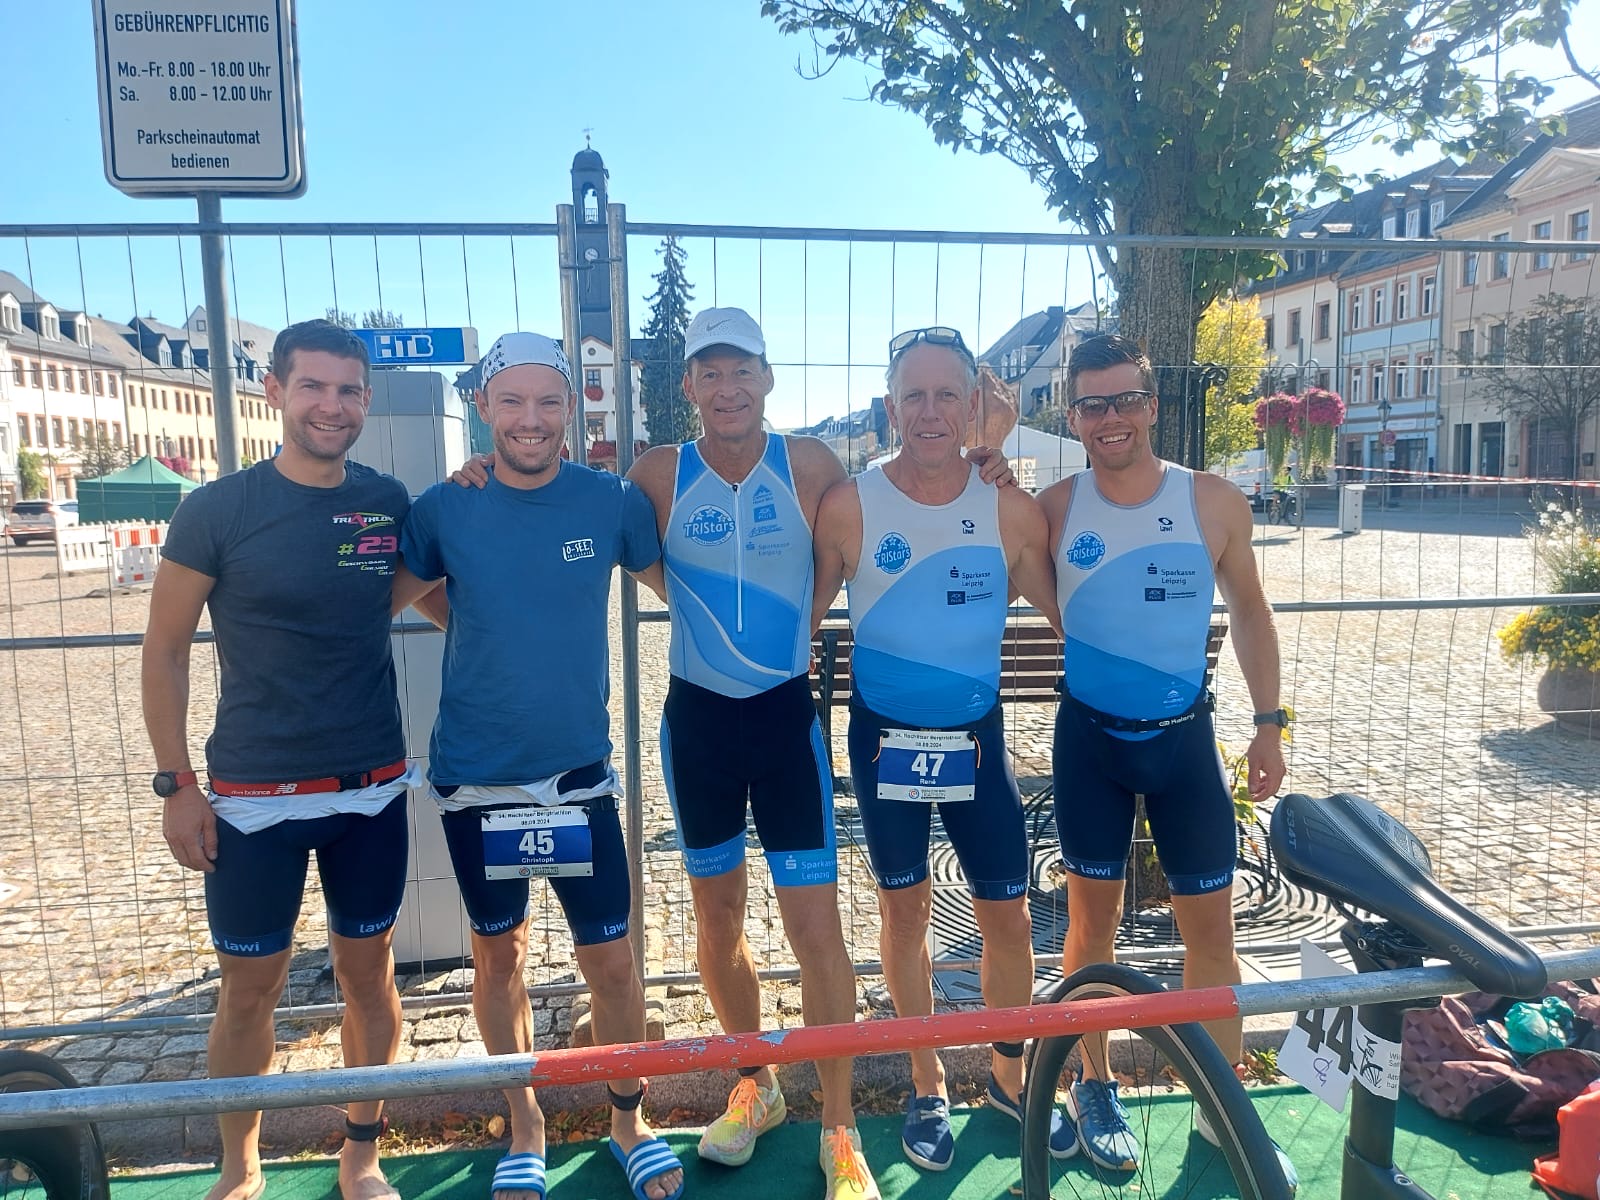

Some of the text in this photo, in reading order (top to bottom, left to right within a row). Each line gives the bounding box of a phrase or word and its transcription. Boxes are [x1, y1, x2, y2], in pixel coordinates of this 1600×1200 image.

[114, 11, 270, 33] GEBÜHRENPFLICHTIG
[168, 61, 195, 77] 8.00
[210, 61, 245, 77] 18.00
[249, 61, 271, 77] Uhr
[119, 86, 140, 101] Sa.
[169, 86, 196, 101] 8.00
[212, 86, 246, 101] 12.00
[250, 86, 273, 101] Uhr
[137, 129, 261, 145] Parkscheinautomat
[171, 153, 230, 169] bedienen
[374, 334, 434, 359] HTB
[684, 521, 736, 538] TRIStars
[875, 547, 911, 566] TRIStars
[1067, 545, 1106, 562] TRIStars
[962, 571, 991, 579] Sparkasse
[1161, 569, 1196, 577] Sparkasse
[911, 752, 945, 776] 47
[518, 829, 555, 855] 45
[802, 871, 830, 880] Leipzig
[1080, 864, 1111, 876] lawi
[885, 872, 914, 886] lawi
[1199, 872, 1229, 889] lawi
[359, 914, 392, 933] lawi
[484, 916, 514, 932] lawi
[224, 939, 260, 952] lawi
[1448, 943, 1481, 969] OVAL
[1296, 1006, 1354, 1075] 44
